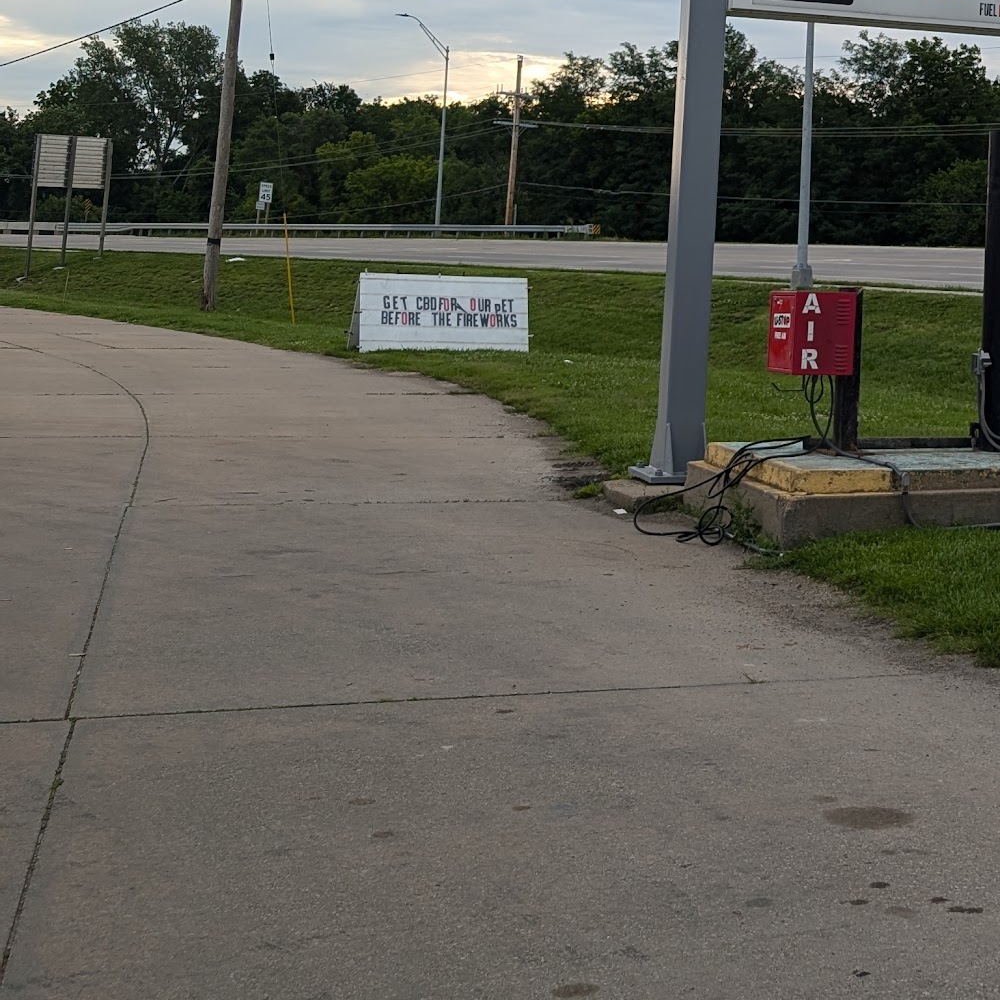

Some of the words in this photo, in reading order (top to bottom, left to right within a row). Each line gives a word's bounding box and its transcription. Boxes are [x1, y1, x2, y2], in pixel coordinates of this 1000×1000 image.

[979, 2, 998, 17] FUEL
[260, 193, 271, 201] 45
[383, 295, 408, 311] GET
[381, 310, 421, 326] BEFORE
[431, 312, 452, 327] THE
[456, 312, 518, 328] FIREWORKS
[801, 292, 822, 370] AIR
